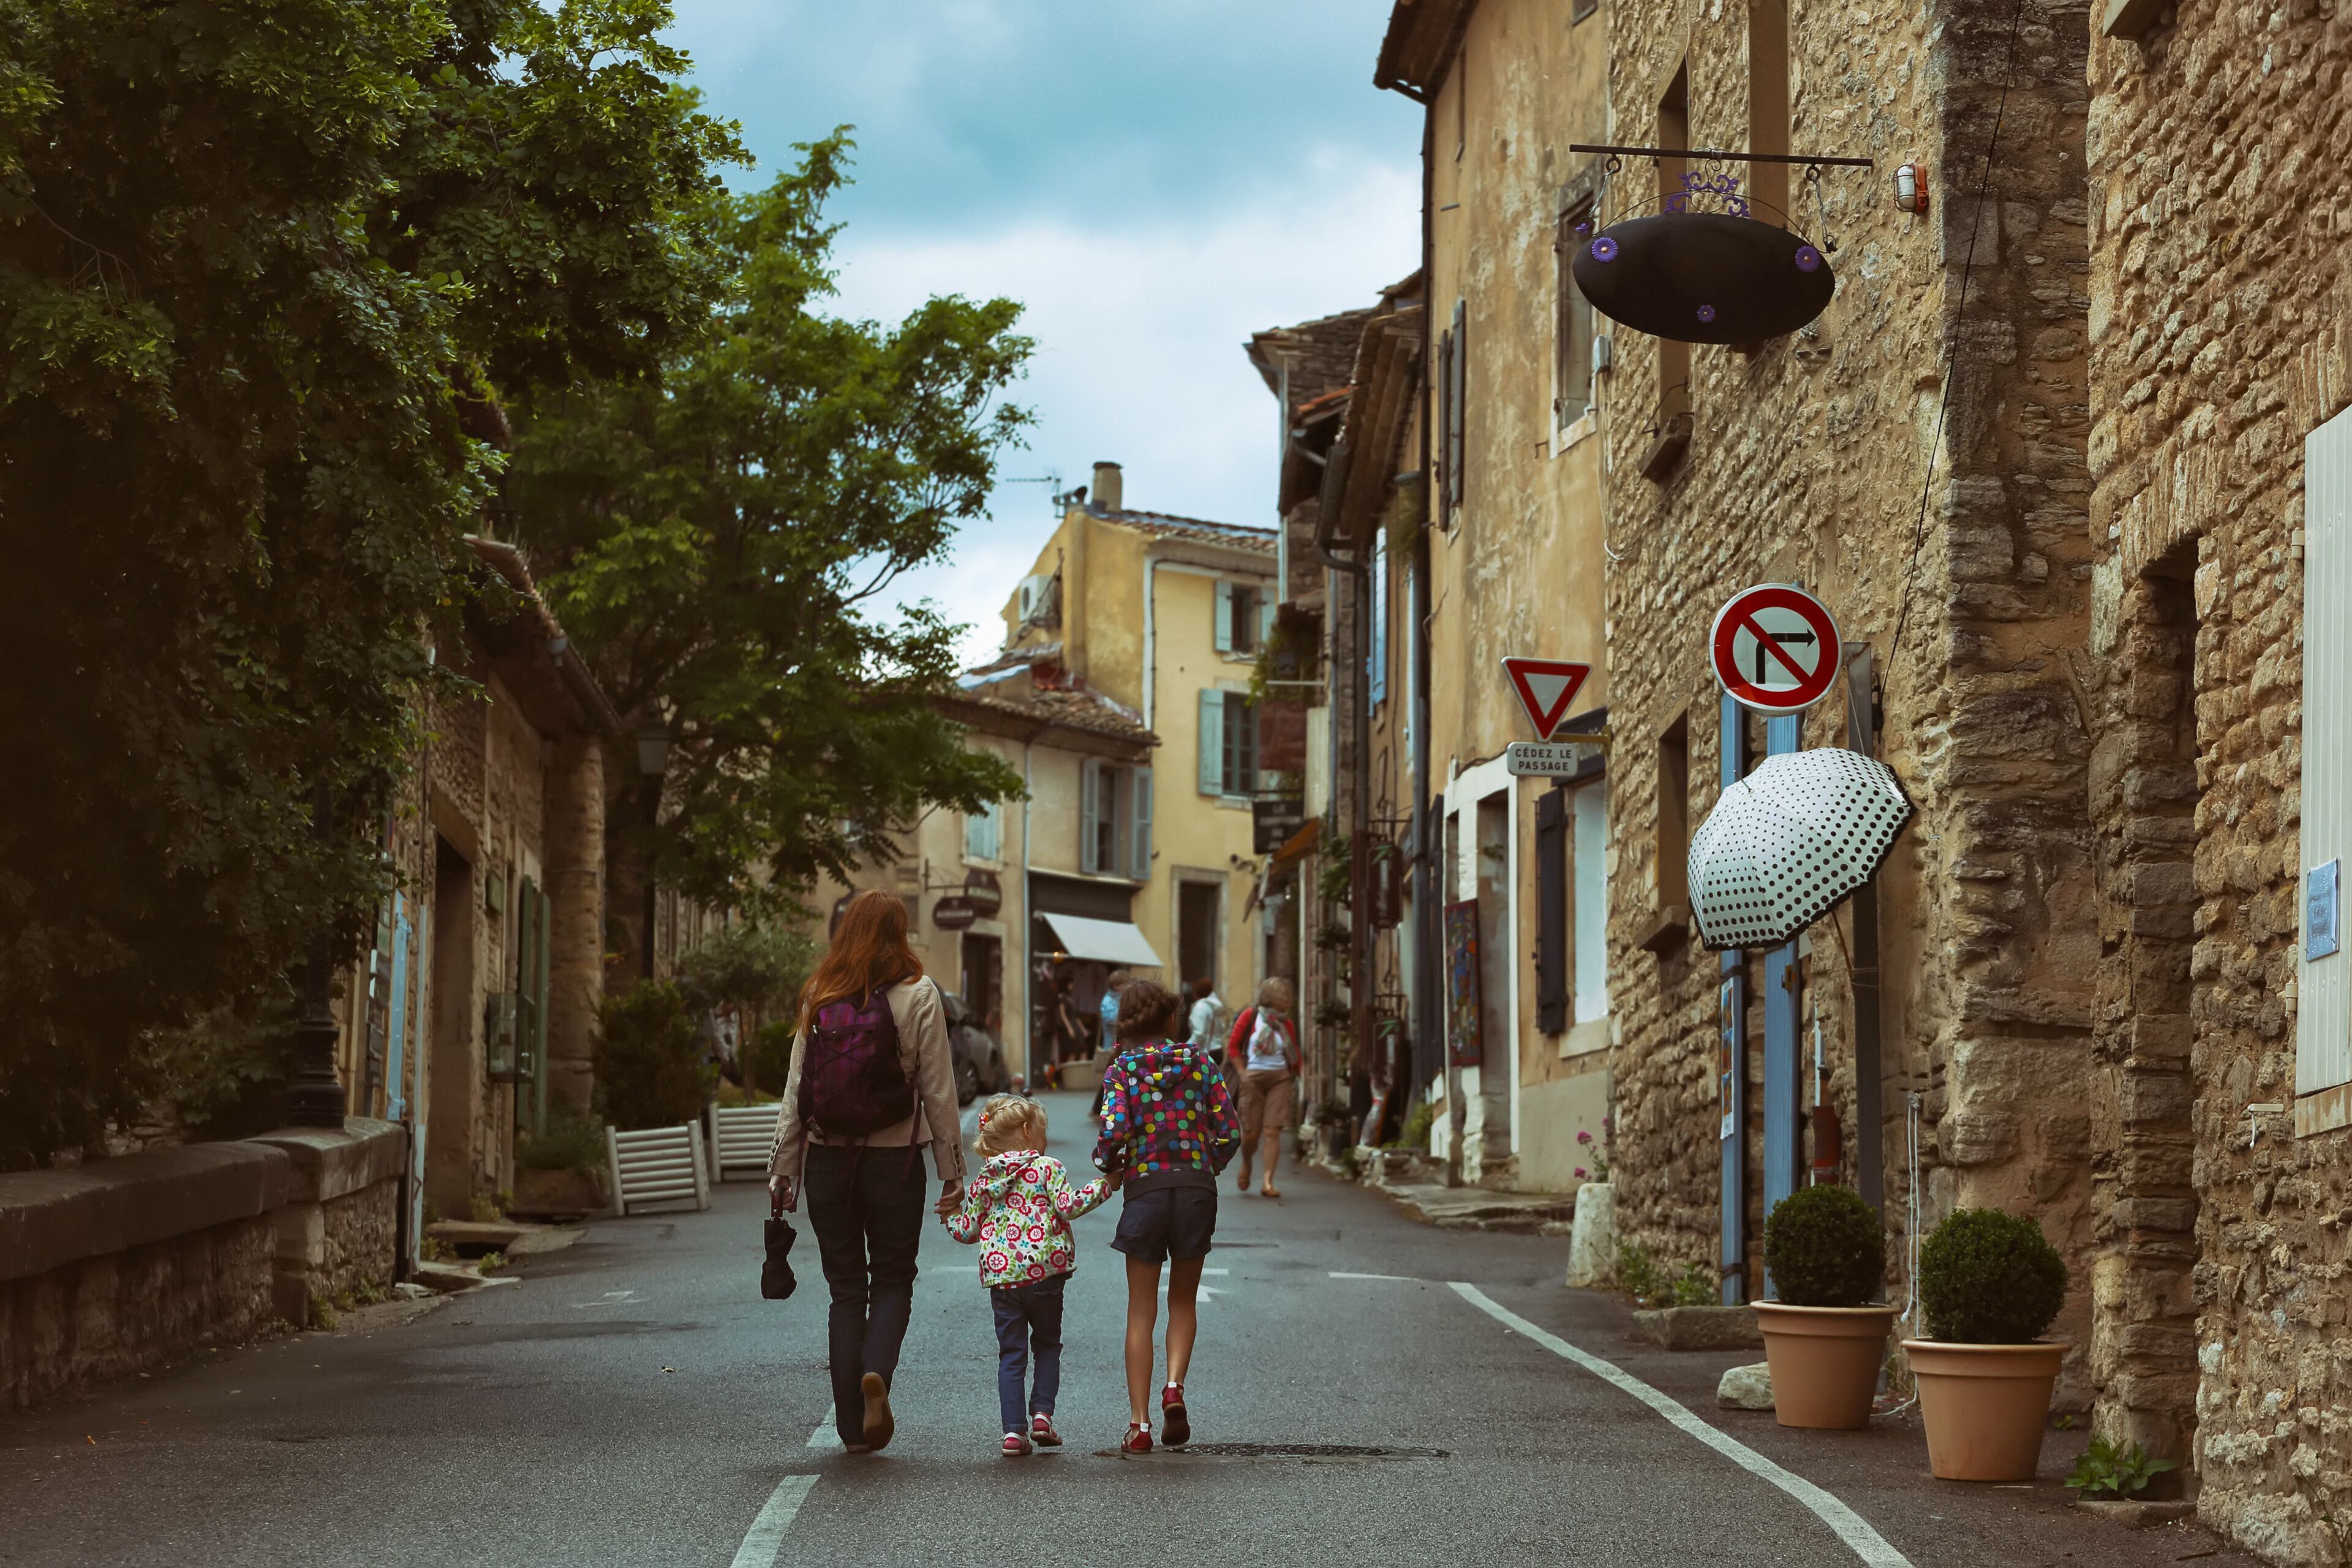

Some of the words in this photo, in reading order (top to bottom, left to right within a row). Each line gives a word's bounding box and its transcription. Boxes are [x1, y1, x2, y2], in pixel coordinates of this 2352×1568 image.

[1515, 746, 1552, 758] CÉDEZ
[1559, 749, 1572, 759] LE
[1518, 761, 1569, 771] PASSAGE
